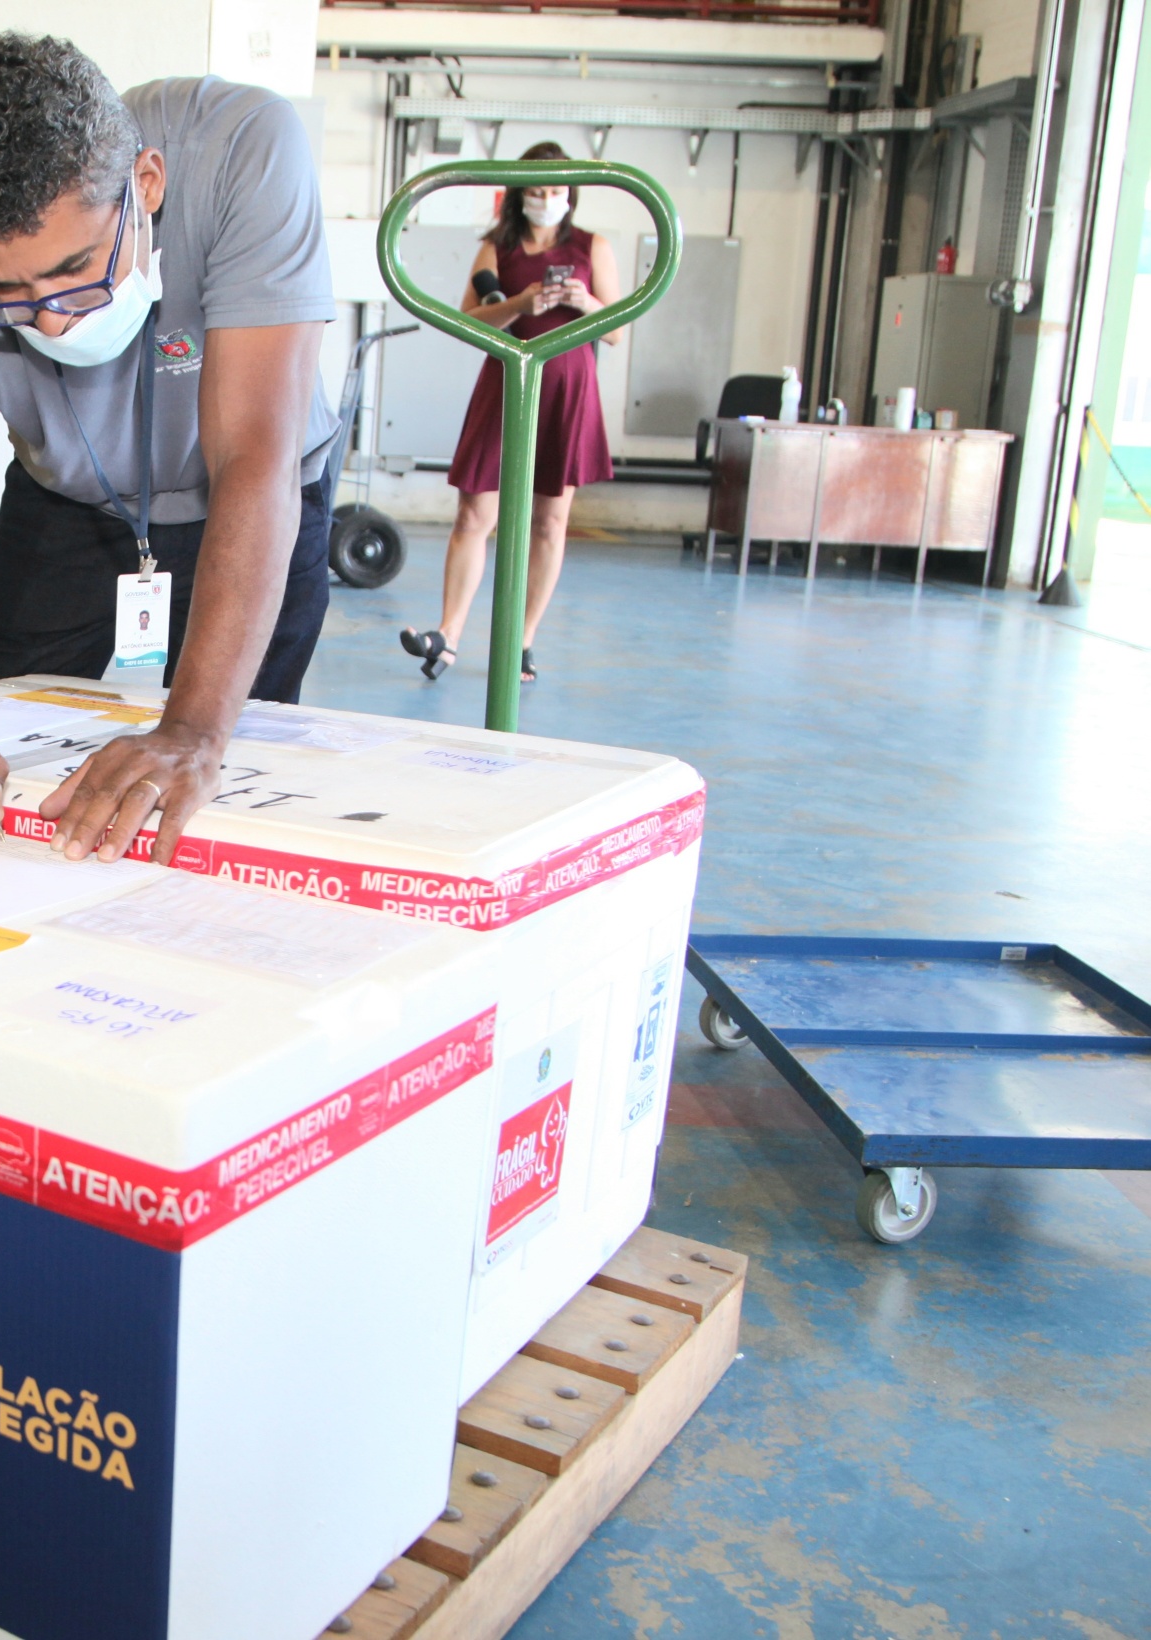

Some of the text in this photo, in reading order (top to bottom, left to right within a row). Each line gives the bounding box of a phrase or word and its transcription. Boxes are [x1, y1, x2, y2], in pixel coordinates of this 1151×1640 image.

[361, 870, 525, 900] MEDICAMENTO
[387, 1041, 471, 1109] ATENÇÃO:
[42, 1093, 352, 1226] ATENÇÃO: MEDICAMENTO
[233, 1136, 334, 1211] PERECÍVEL
[491, 1165, 535, 1206] CUIDADO
[494, 1131, 537, 1185] FRÁGIL
